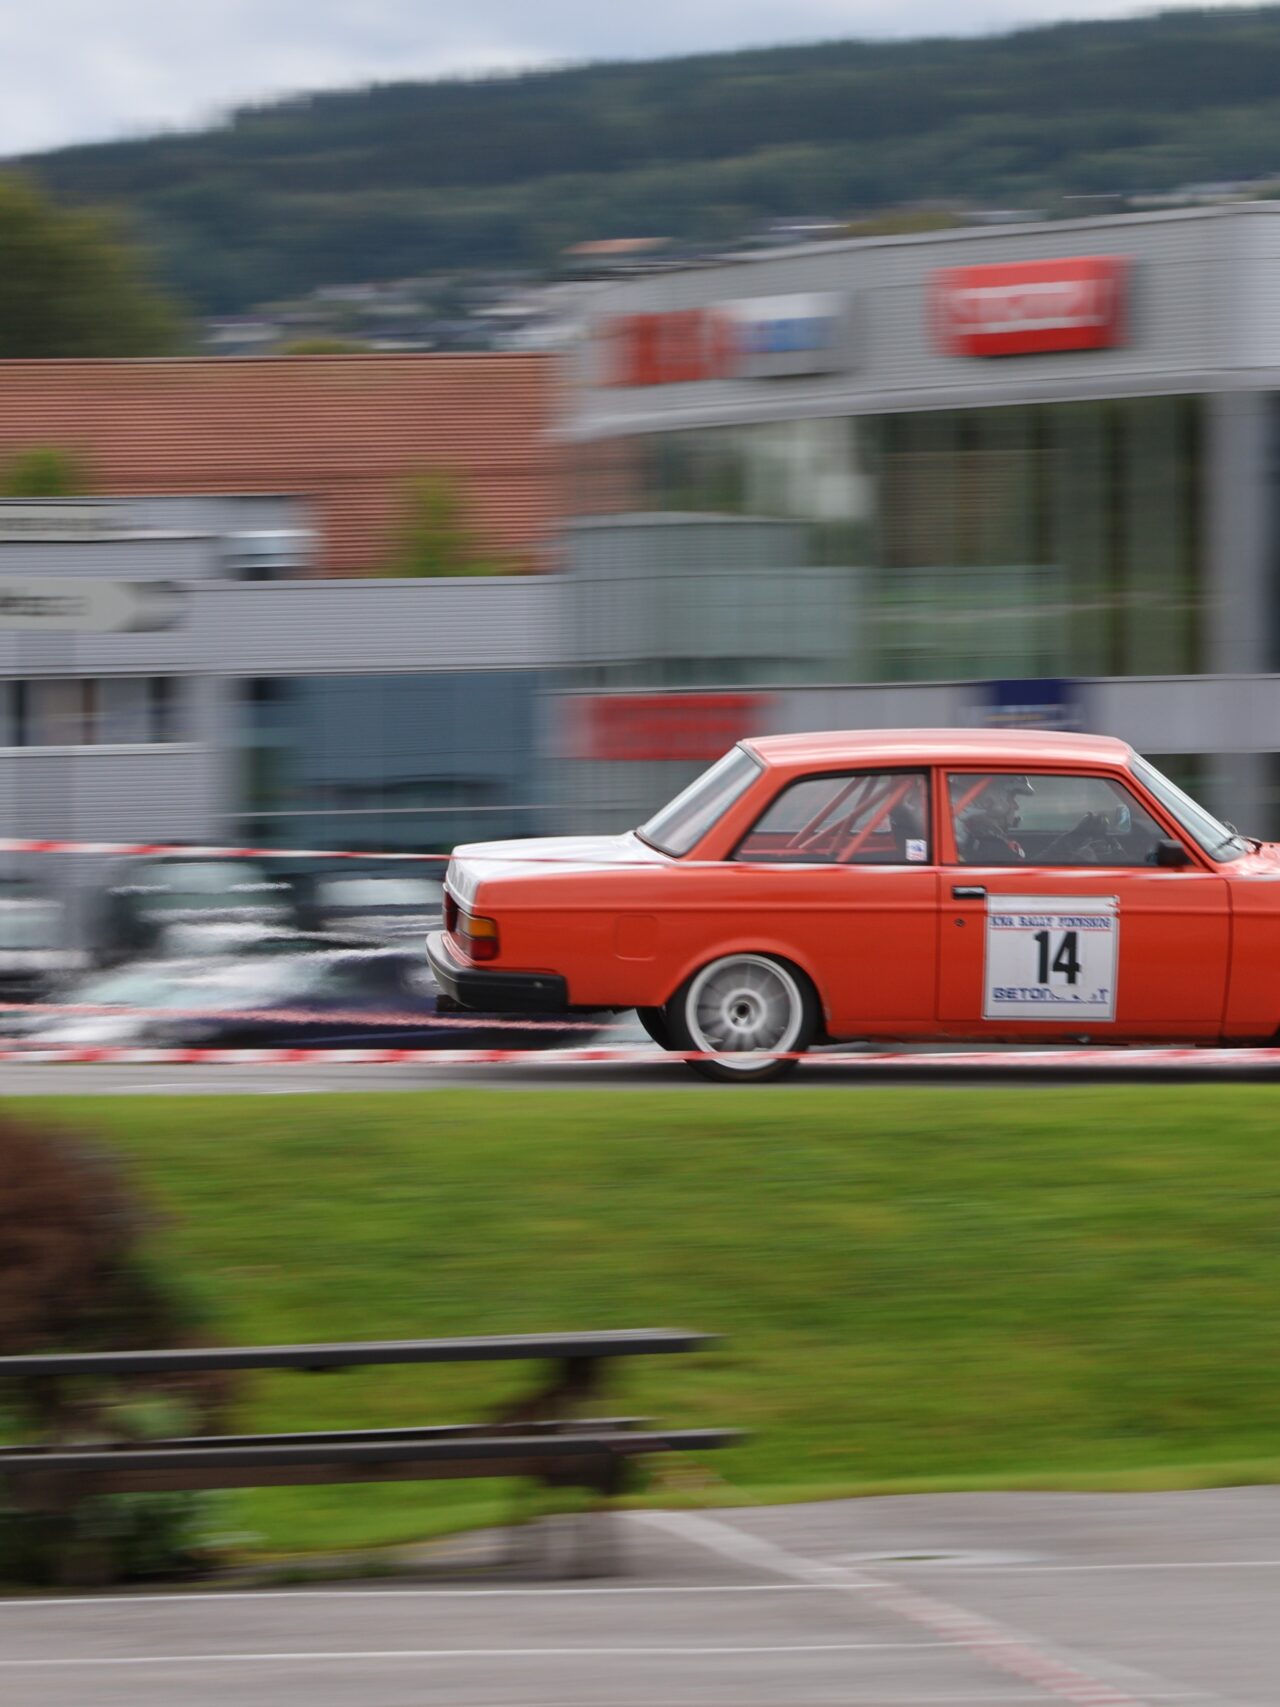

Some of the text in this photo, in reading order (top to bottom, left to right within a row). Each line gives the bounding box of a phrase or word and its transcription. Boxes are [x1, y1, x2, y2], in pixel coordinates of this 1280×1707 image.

[1018, 916, 1053, 927] RALLY
[1034, 930, 1081, 984] 14
[992, 987, 1109, 1000] BETONT
